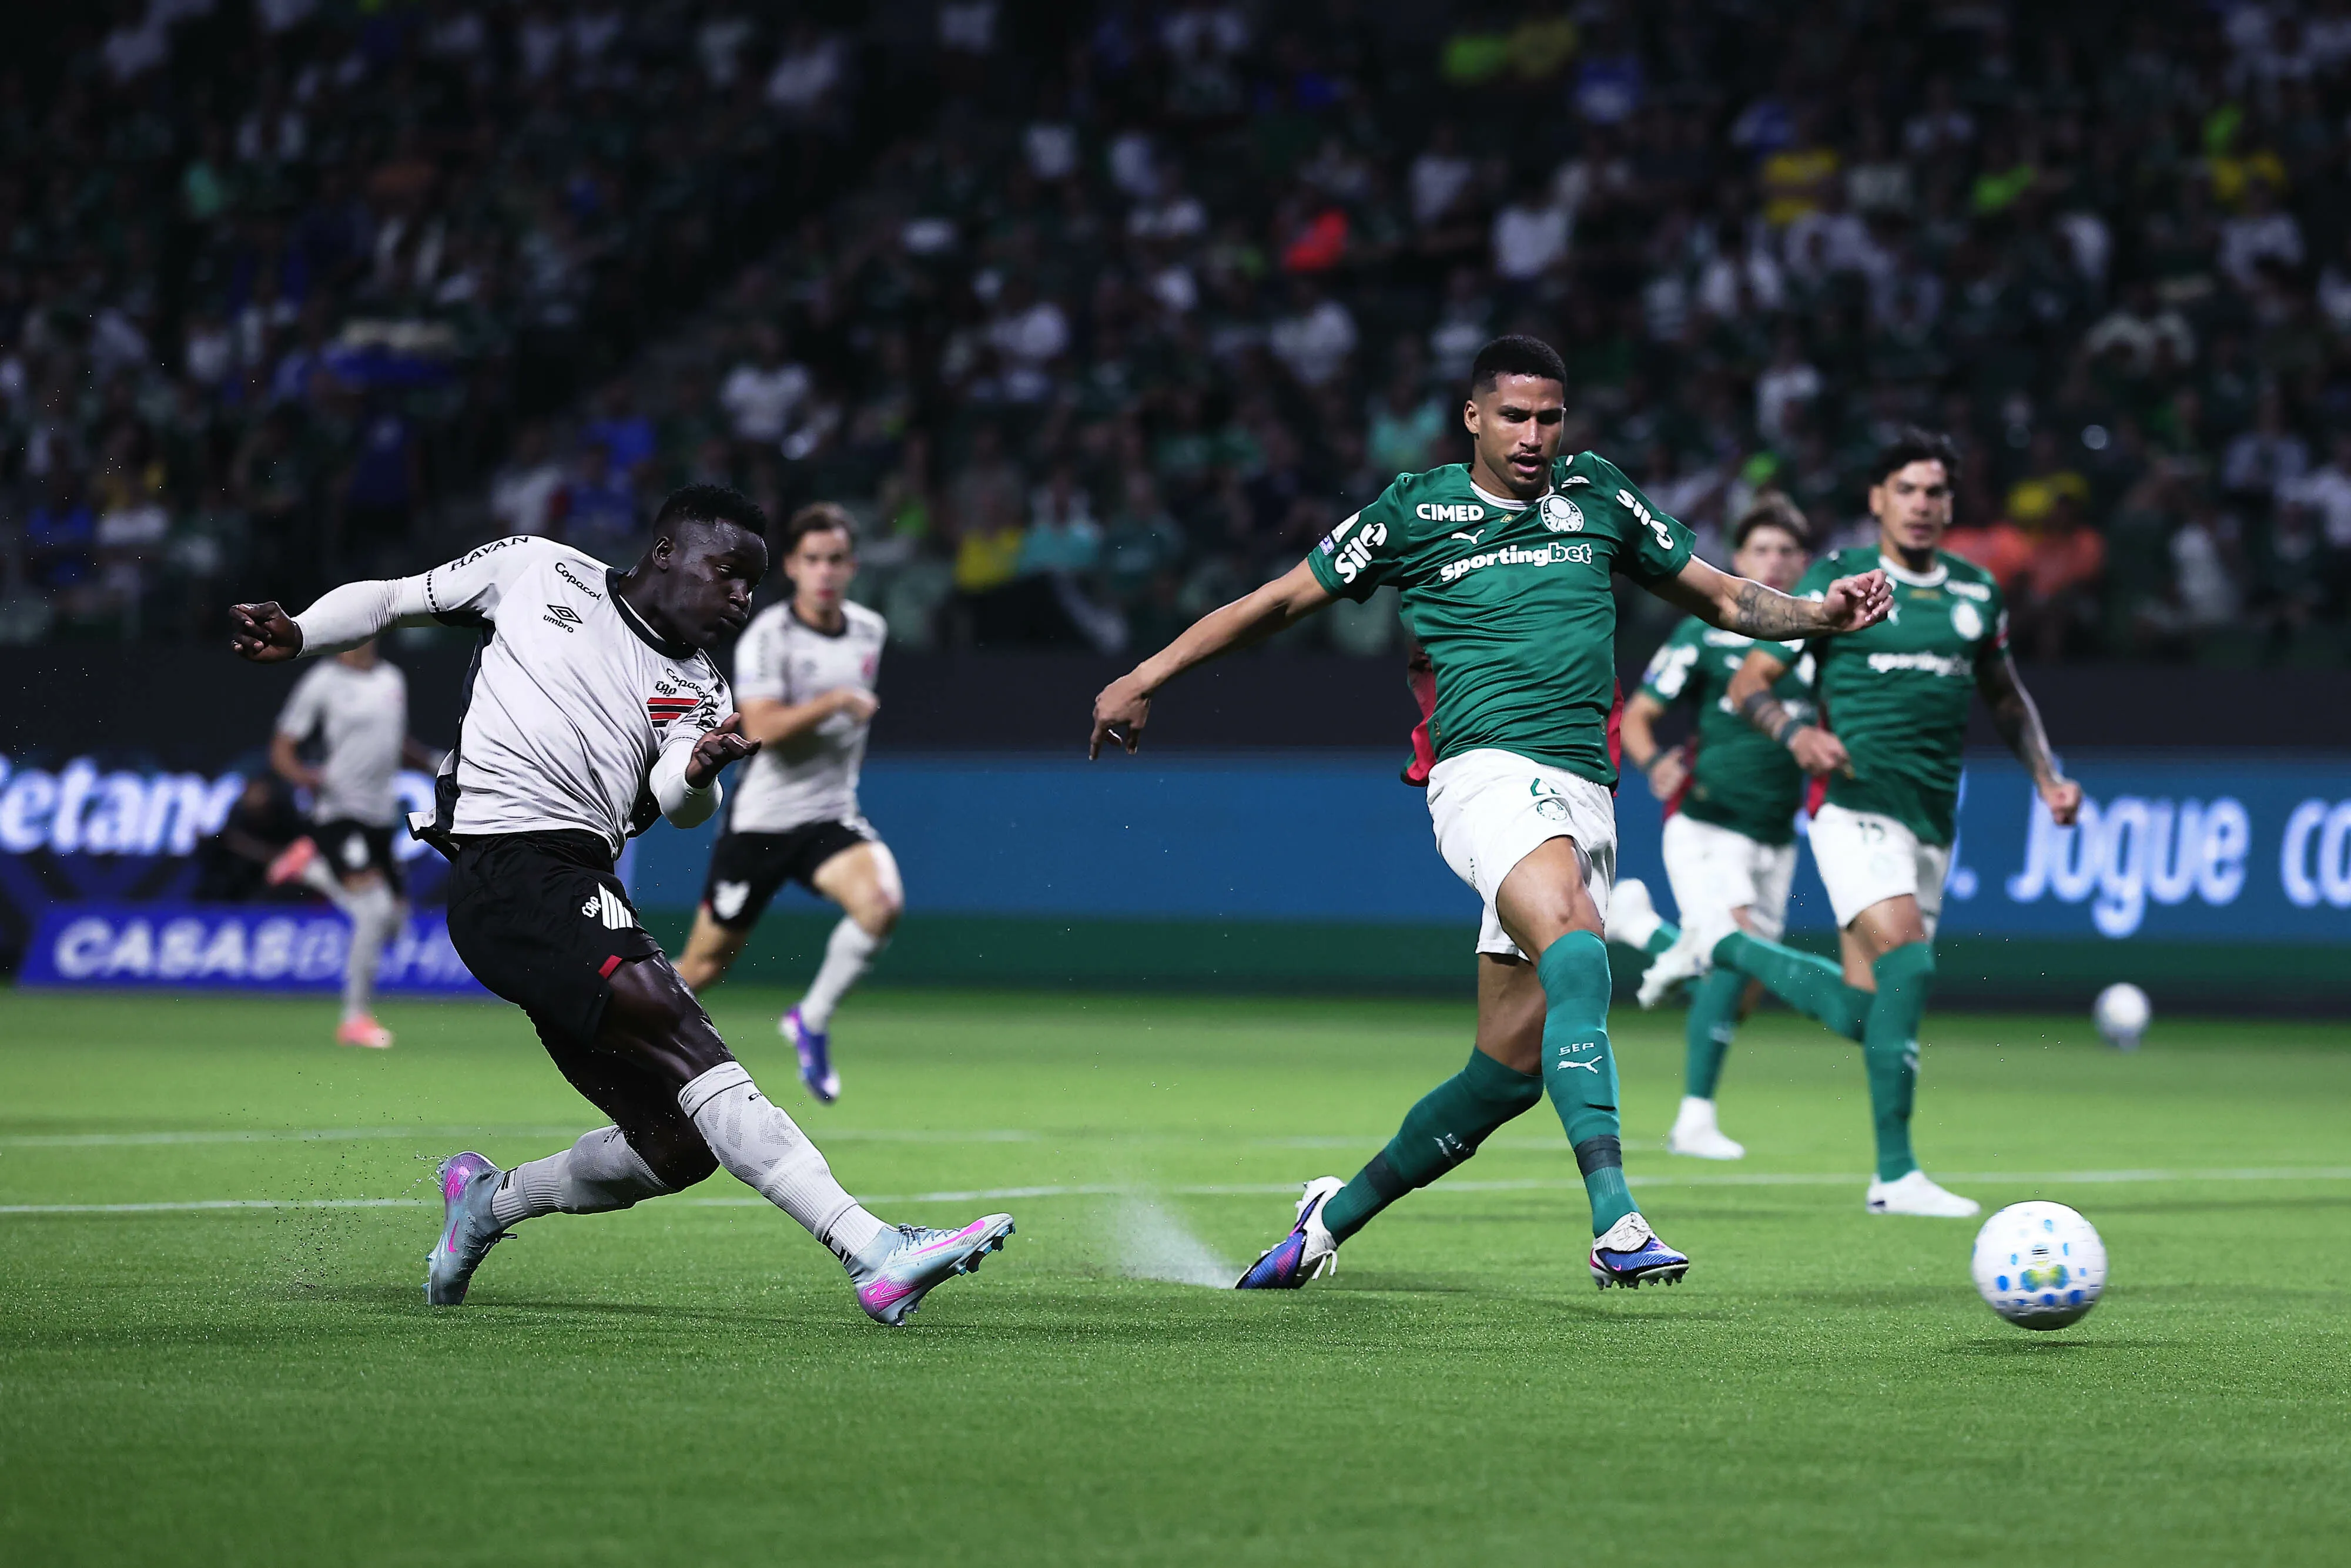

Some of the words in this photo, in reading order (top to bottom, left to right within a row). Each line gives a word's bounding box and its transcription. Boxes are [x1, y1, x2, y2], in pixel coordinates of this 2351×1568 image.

[1415, 503, 1485, 522] CIMED
[450, 537, 529, 572] HAVAN
[1439, 542, 1593, 582] sportingbet
[555, 562, 602, 601] Copacol
[543, 615, 574, 633] umbro
[666, 668, 706, 699] Copaco
[1558, 1042, 1595, 1056] SEP
